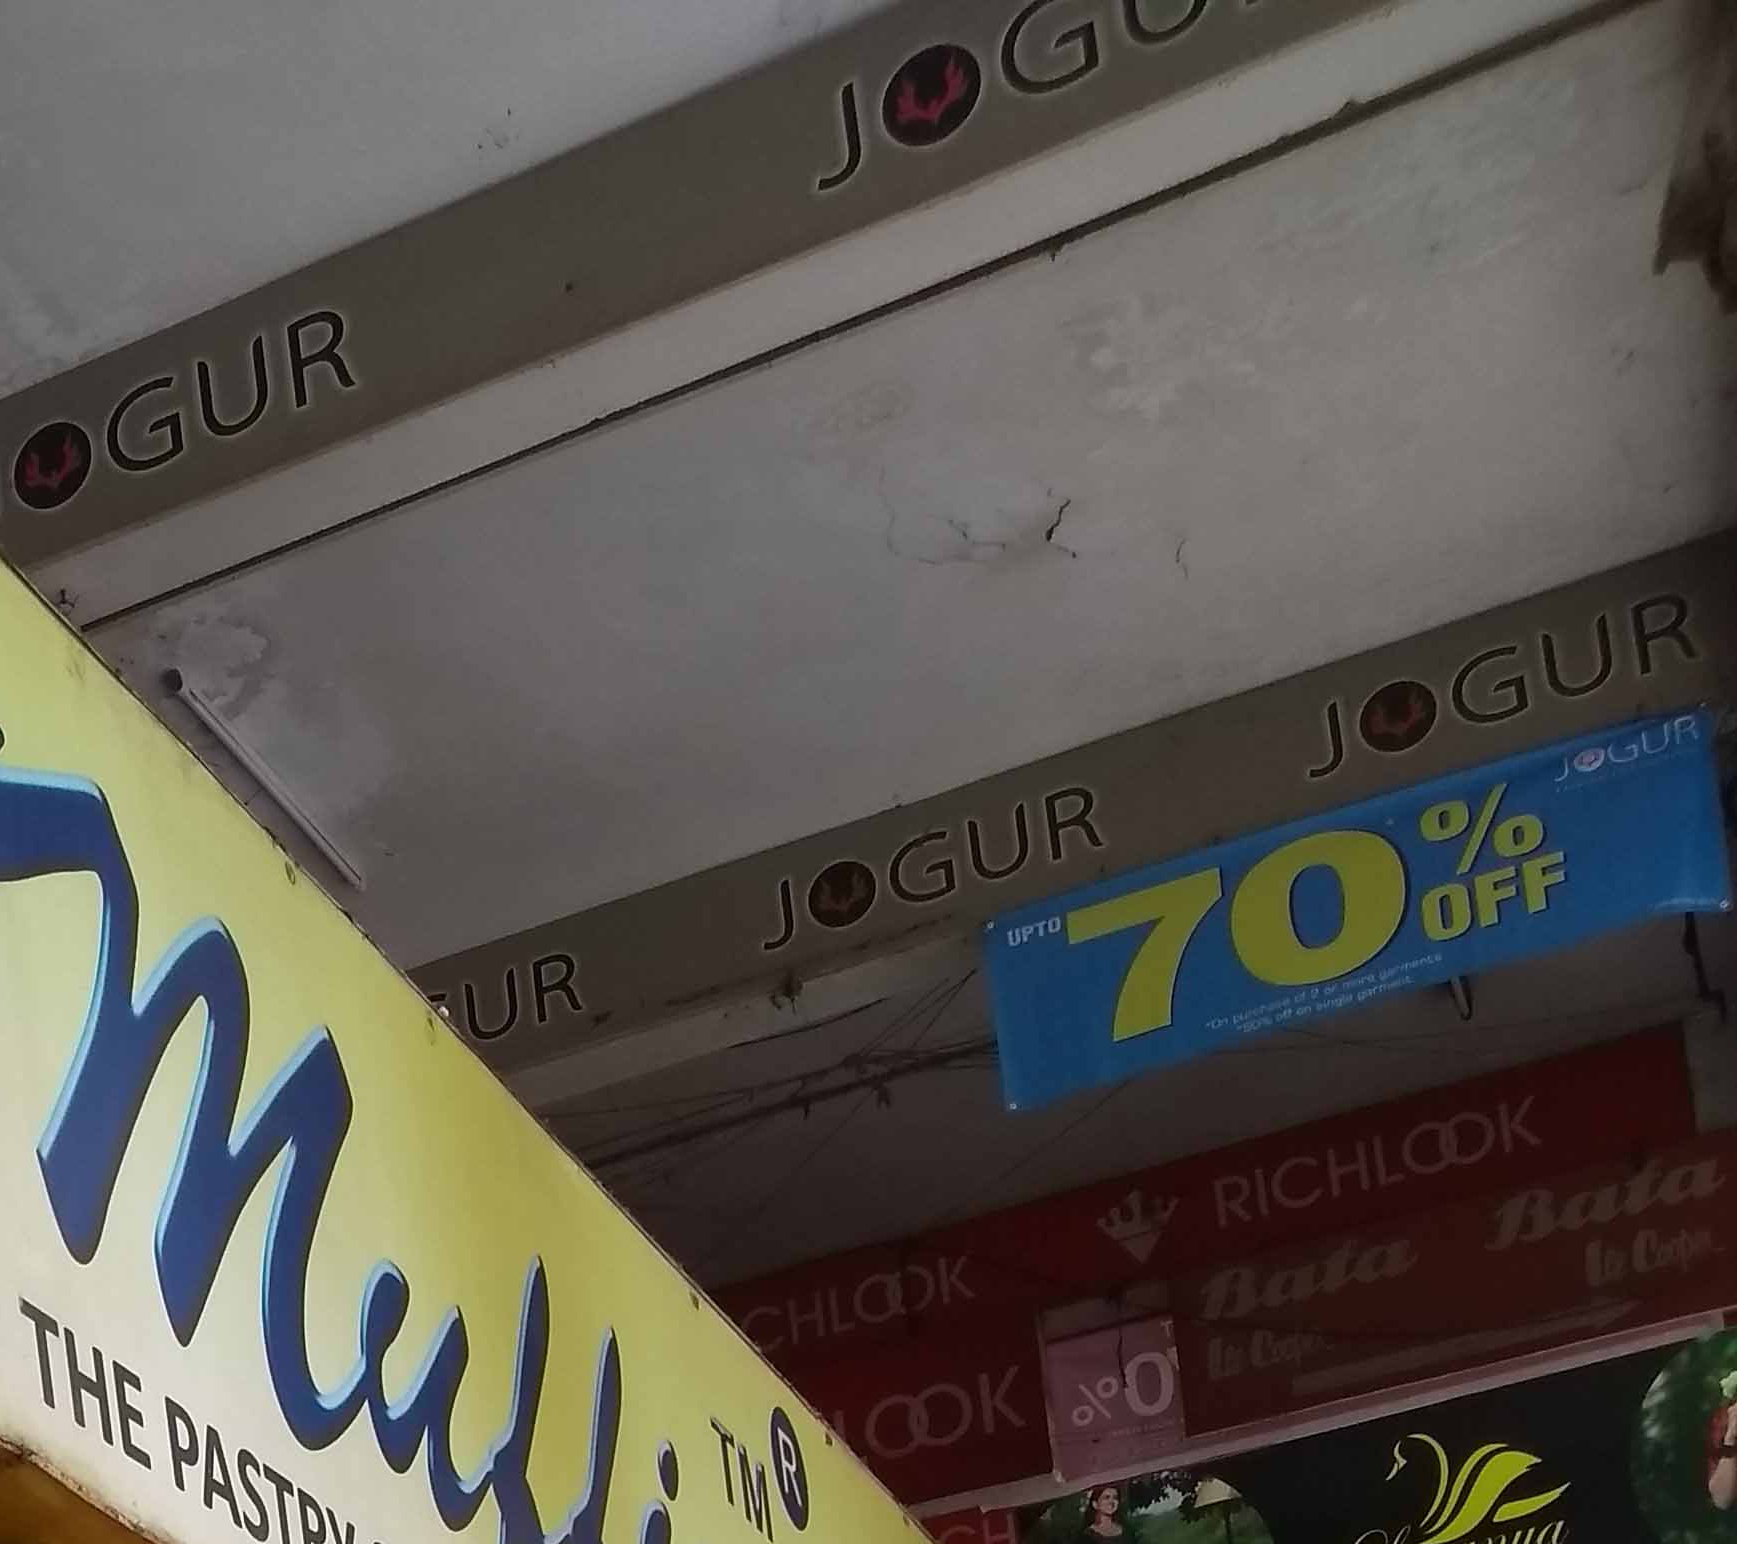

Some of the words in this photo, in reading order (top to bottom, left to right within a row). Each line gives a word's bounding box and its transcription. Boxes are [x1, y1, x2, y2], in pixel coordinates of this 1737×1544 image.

[1307, 594, 1701, 779] JOGUR
[1554, 714, 1699, 782] JOGUR
[763, 786, 1104, 952] JOGUR
[1007, 916, 1062, 948] UPTO
[1066, 828, 1408, 1043] 70
[1421, 850, 1567, 943] OFF
[1212, 1094, 1544, 1230] RICHLOOK
[1484, 1153, 1728, 1251] Bata
[1195, 1239, 1420, 1322] Bata
[18, 1295, 155, 1474] THE
